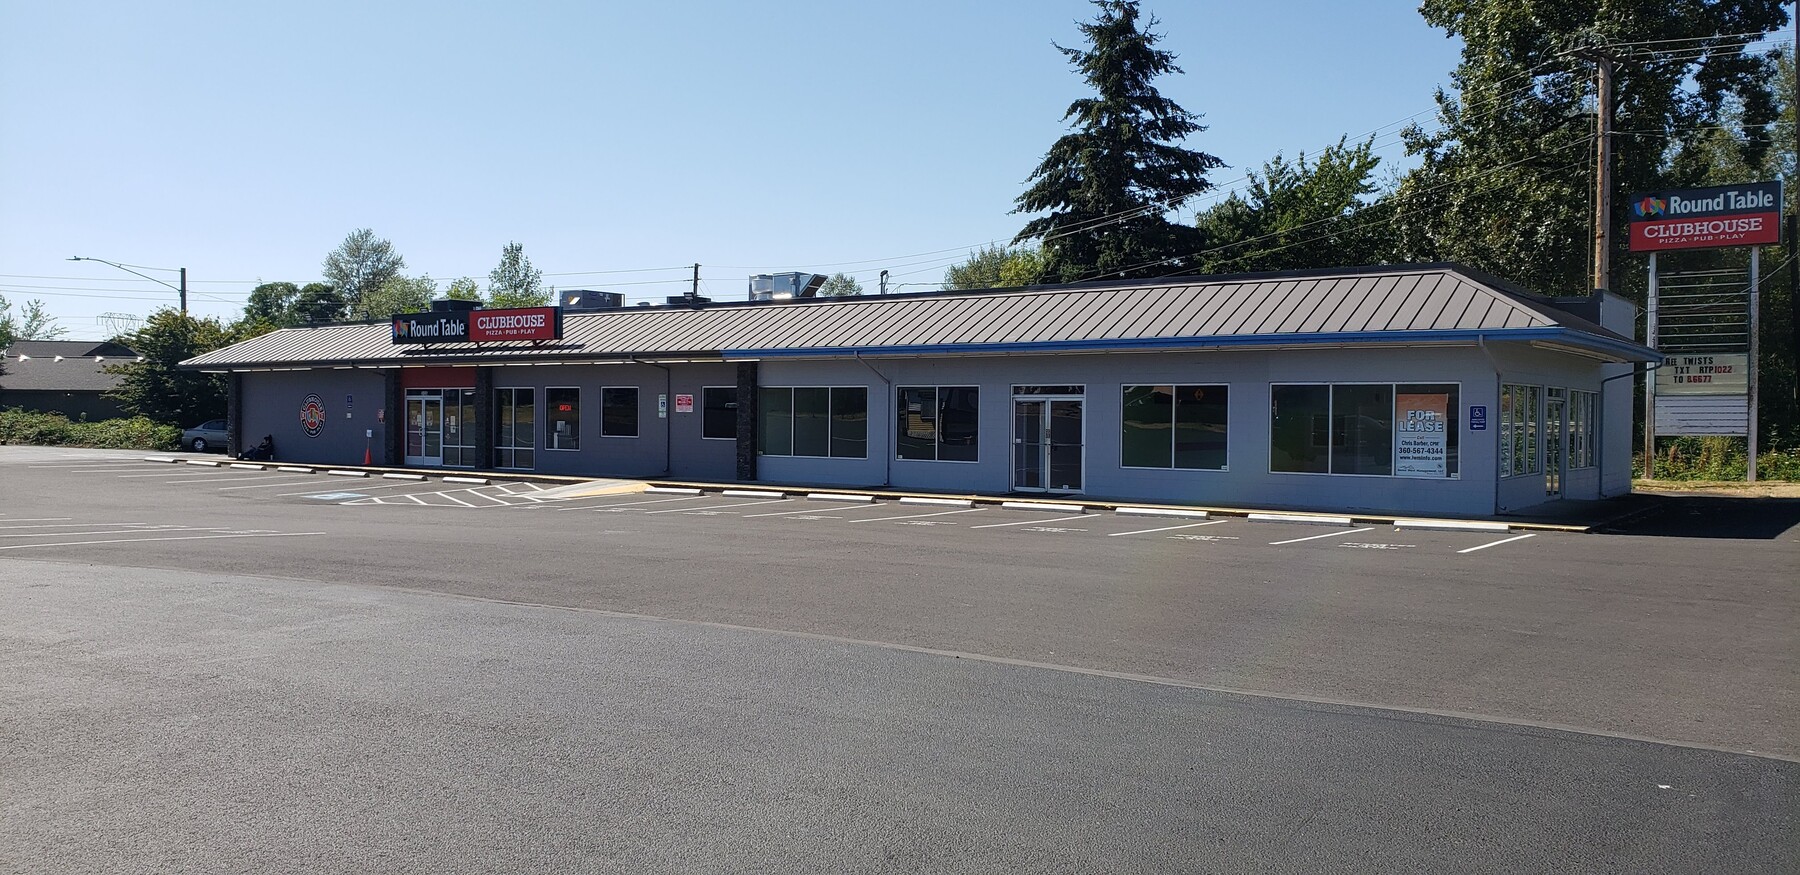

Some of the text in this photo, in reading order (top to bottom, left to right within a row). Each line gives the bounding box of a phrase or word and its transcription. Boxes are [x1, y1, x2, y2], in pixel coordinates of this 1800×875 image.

[1669, 190, 1774, 214] Round Table
[1644, 217, 1763, 238] CLUBHOUSE
[477, 314, 545, 330] CLUBHOUSE
[410, 318, 465, 338] Round Table
[1665, 357, 1714, 366] REE TWISTS
[1674, 366, 1690, 374] TXT
[1673, 375, 1684, 384] TO
[1406, 410, 1436, 421] FOR
[1398, 421, 1444, 433] LEASE
[1398, 447, 1443, 455] 360-567-4344
